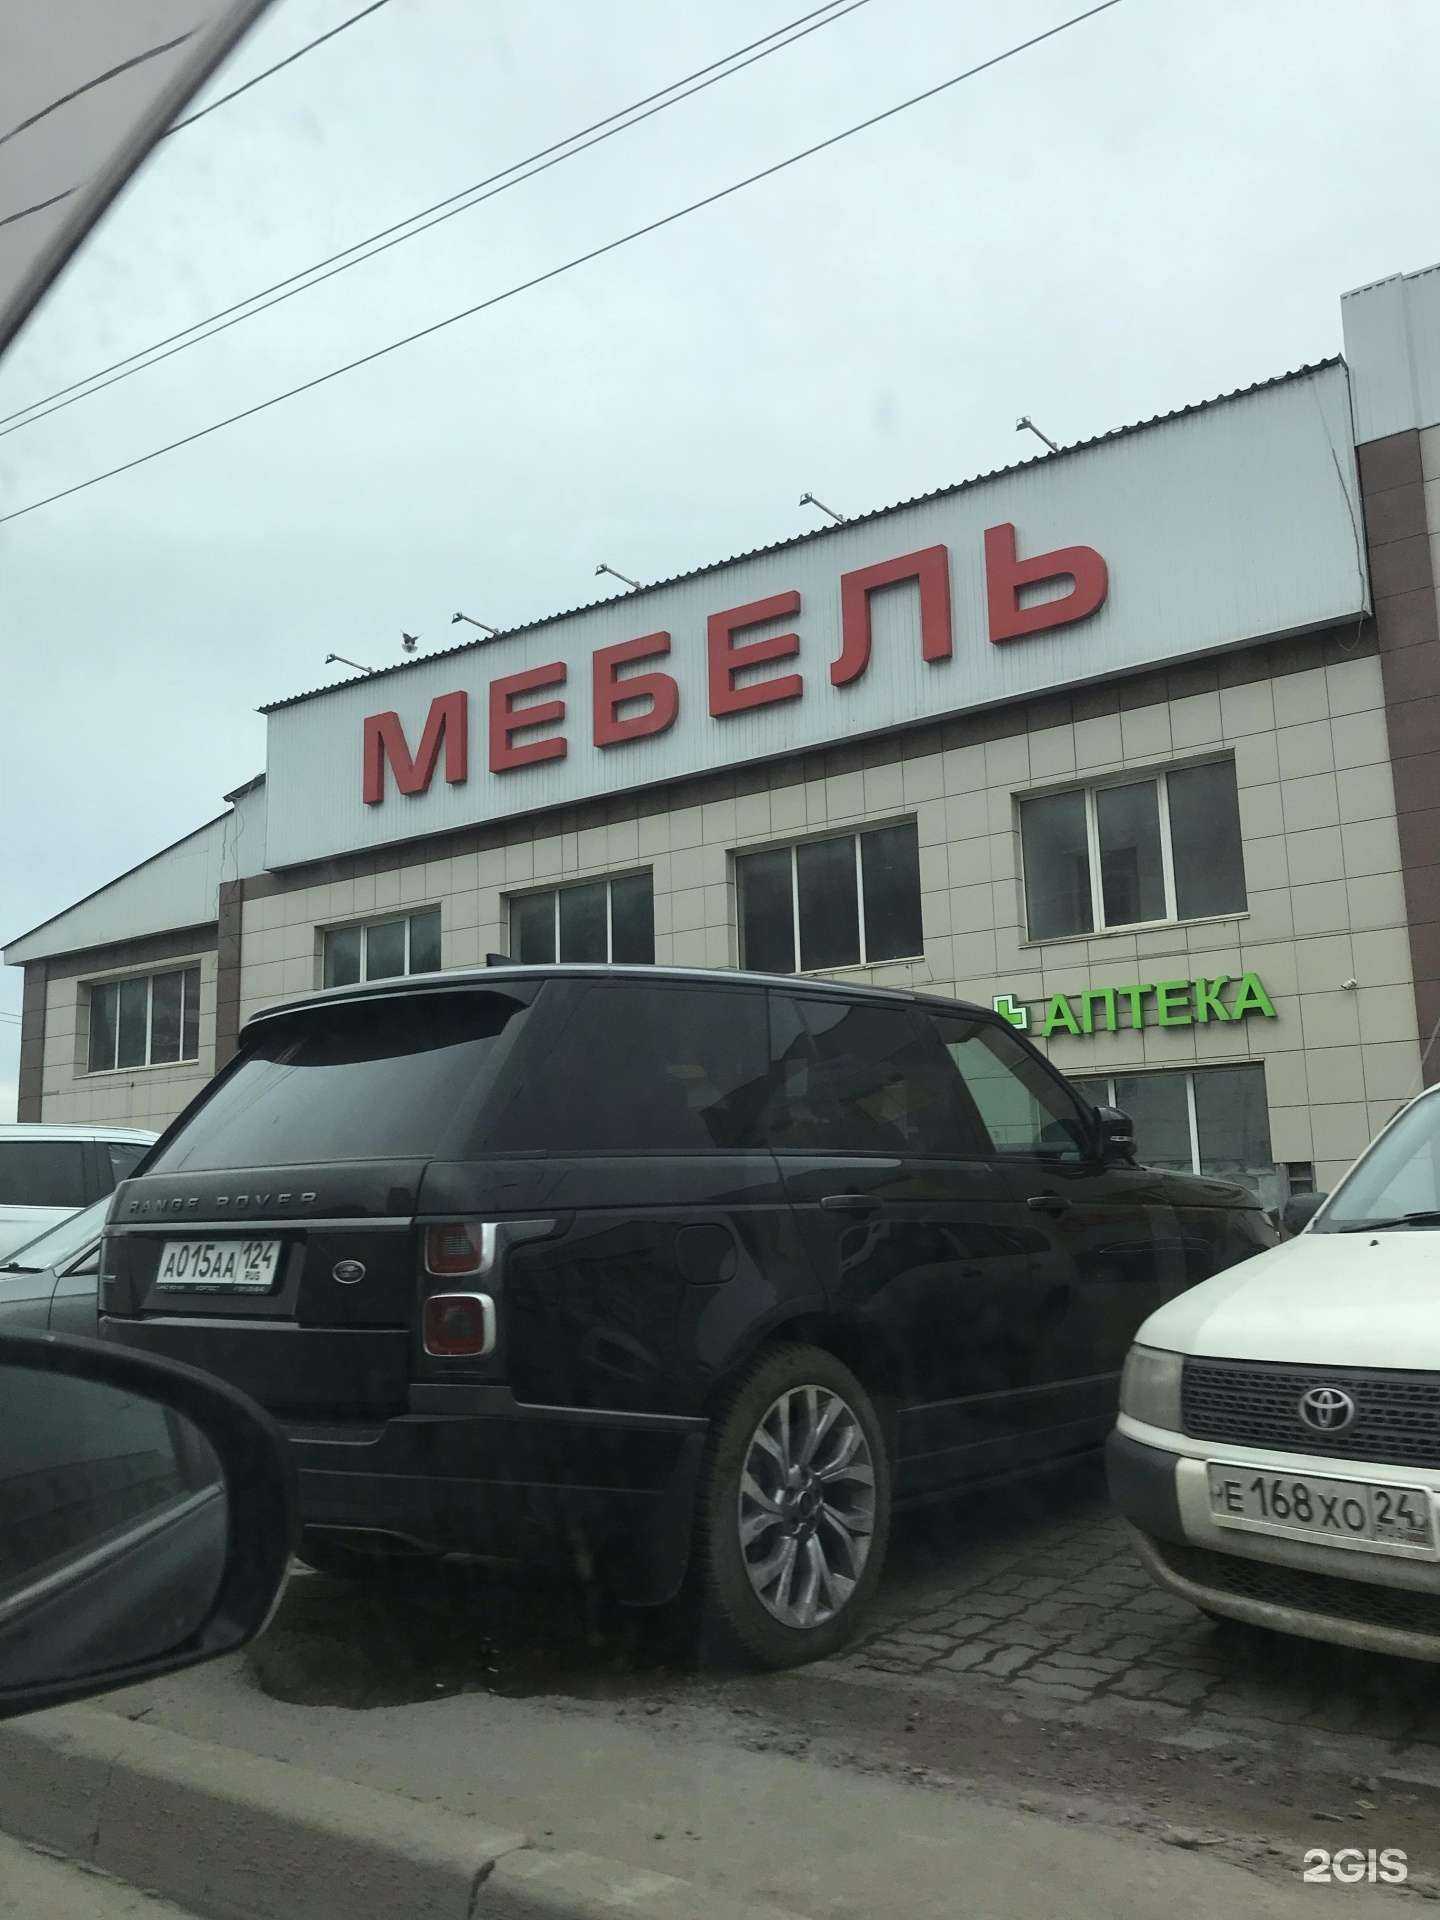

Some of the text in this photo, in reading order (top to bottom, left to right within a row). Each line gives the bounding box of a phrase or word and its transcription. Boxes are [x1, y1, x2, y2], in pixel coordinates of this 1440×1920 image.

[363, 522, 1109, 806] МЕБЕЛЬ
[1040, 972, 1278, 1037] АПТЕКА
[129, 1192, 318, 1214] RANGE ROVER
[241, 1241, 273, 1270] 124
[1374, 1490, 1415, 1528] 24
